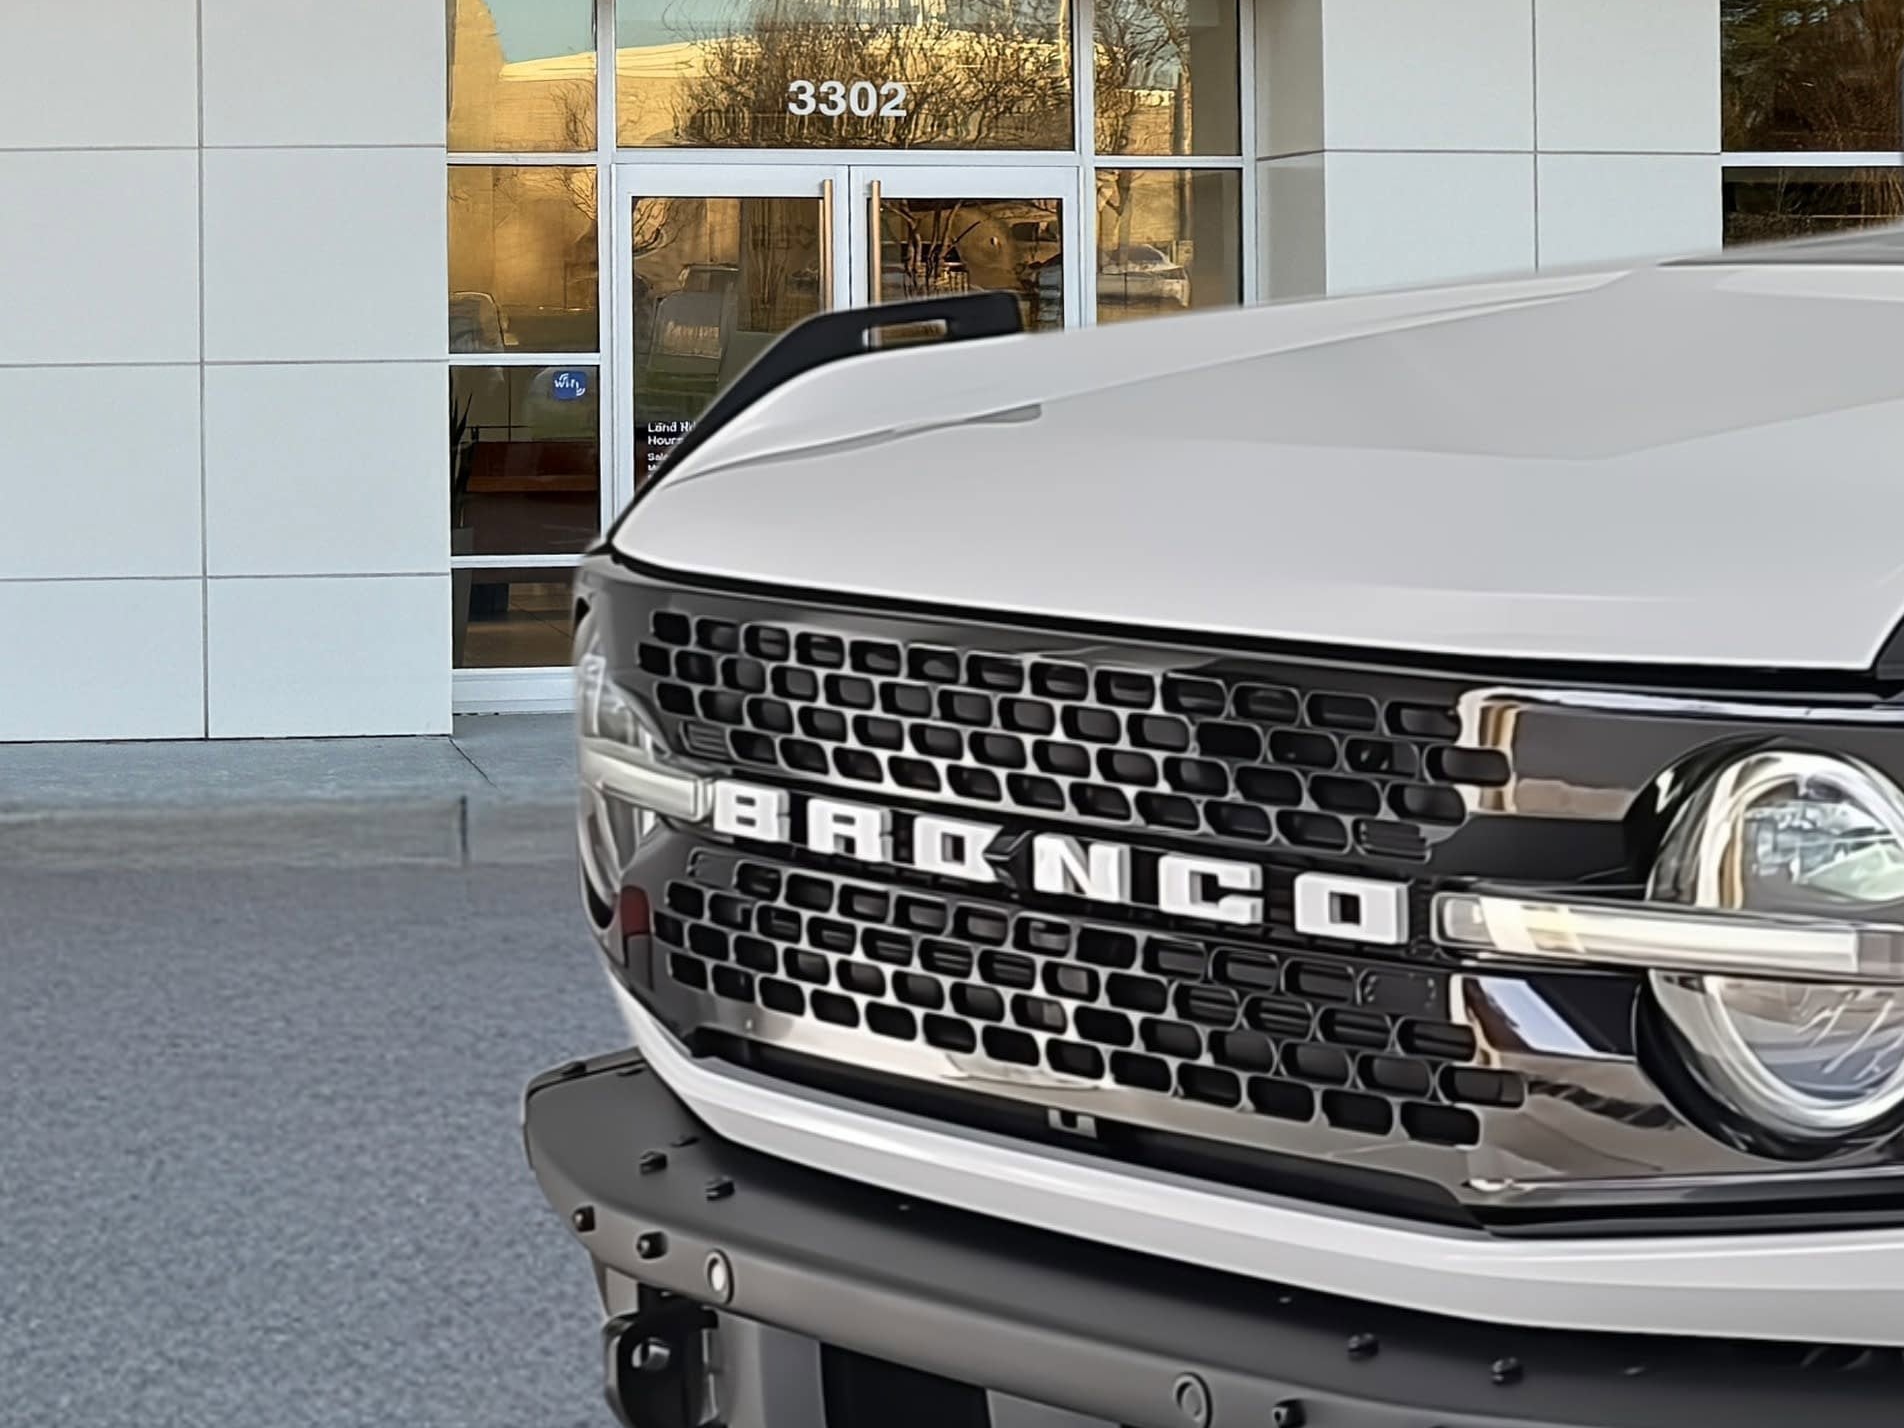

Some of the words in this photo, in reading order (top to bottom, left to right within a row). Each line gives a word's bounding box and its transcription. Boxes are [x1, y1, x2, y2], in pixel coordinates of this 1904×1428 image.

[788, 80, 907, 117] 3302
[647, 422, 677, 432] Land
[713, 778, 1410, 946] BRONCO
